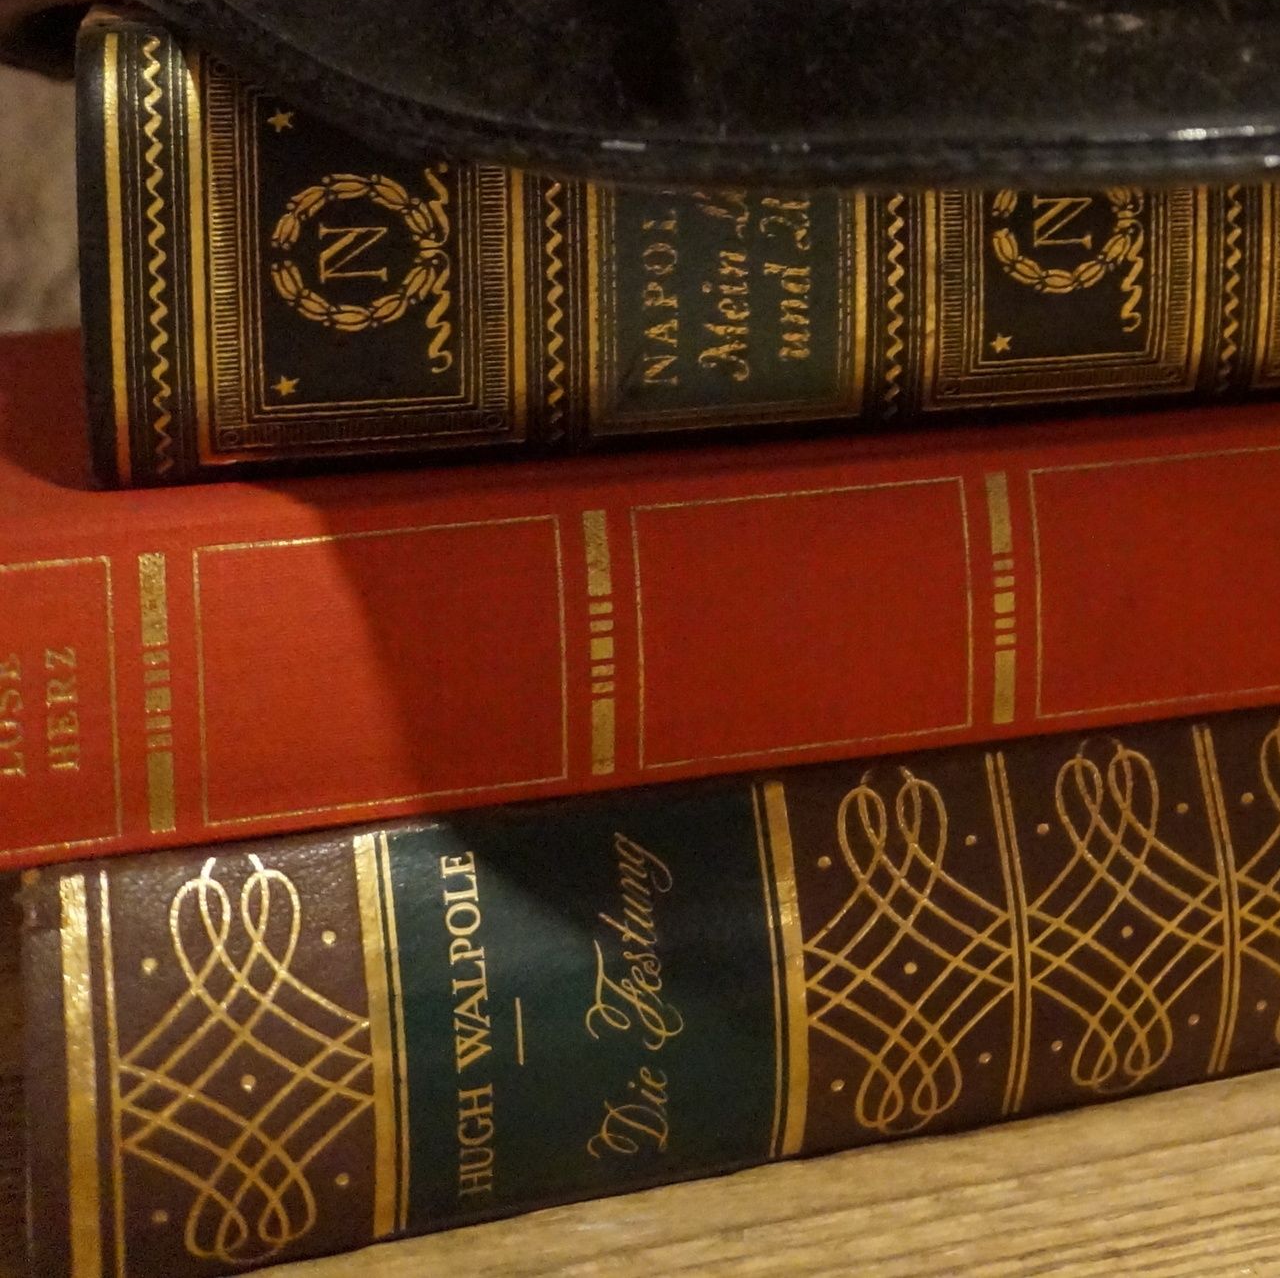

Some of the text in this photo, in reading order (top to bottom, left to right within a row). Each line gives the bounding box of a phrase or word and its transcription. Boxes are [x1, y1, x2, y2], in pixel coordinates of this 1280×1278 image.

[642, 189, 679, 386] NAPOL
[698, 250, 750, 382] Mein
[763, 262, 811, 361] und
[45, 646, 80, 771] HERZ
[440, 850, 494, 1197] HUGH WALPOLE
[586, 832, 684, 1159] Die Festung
